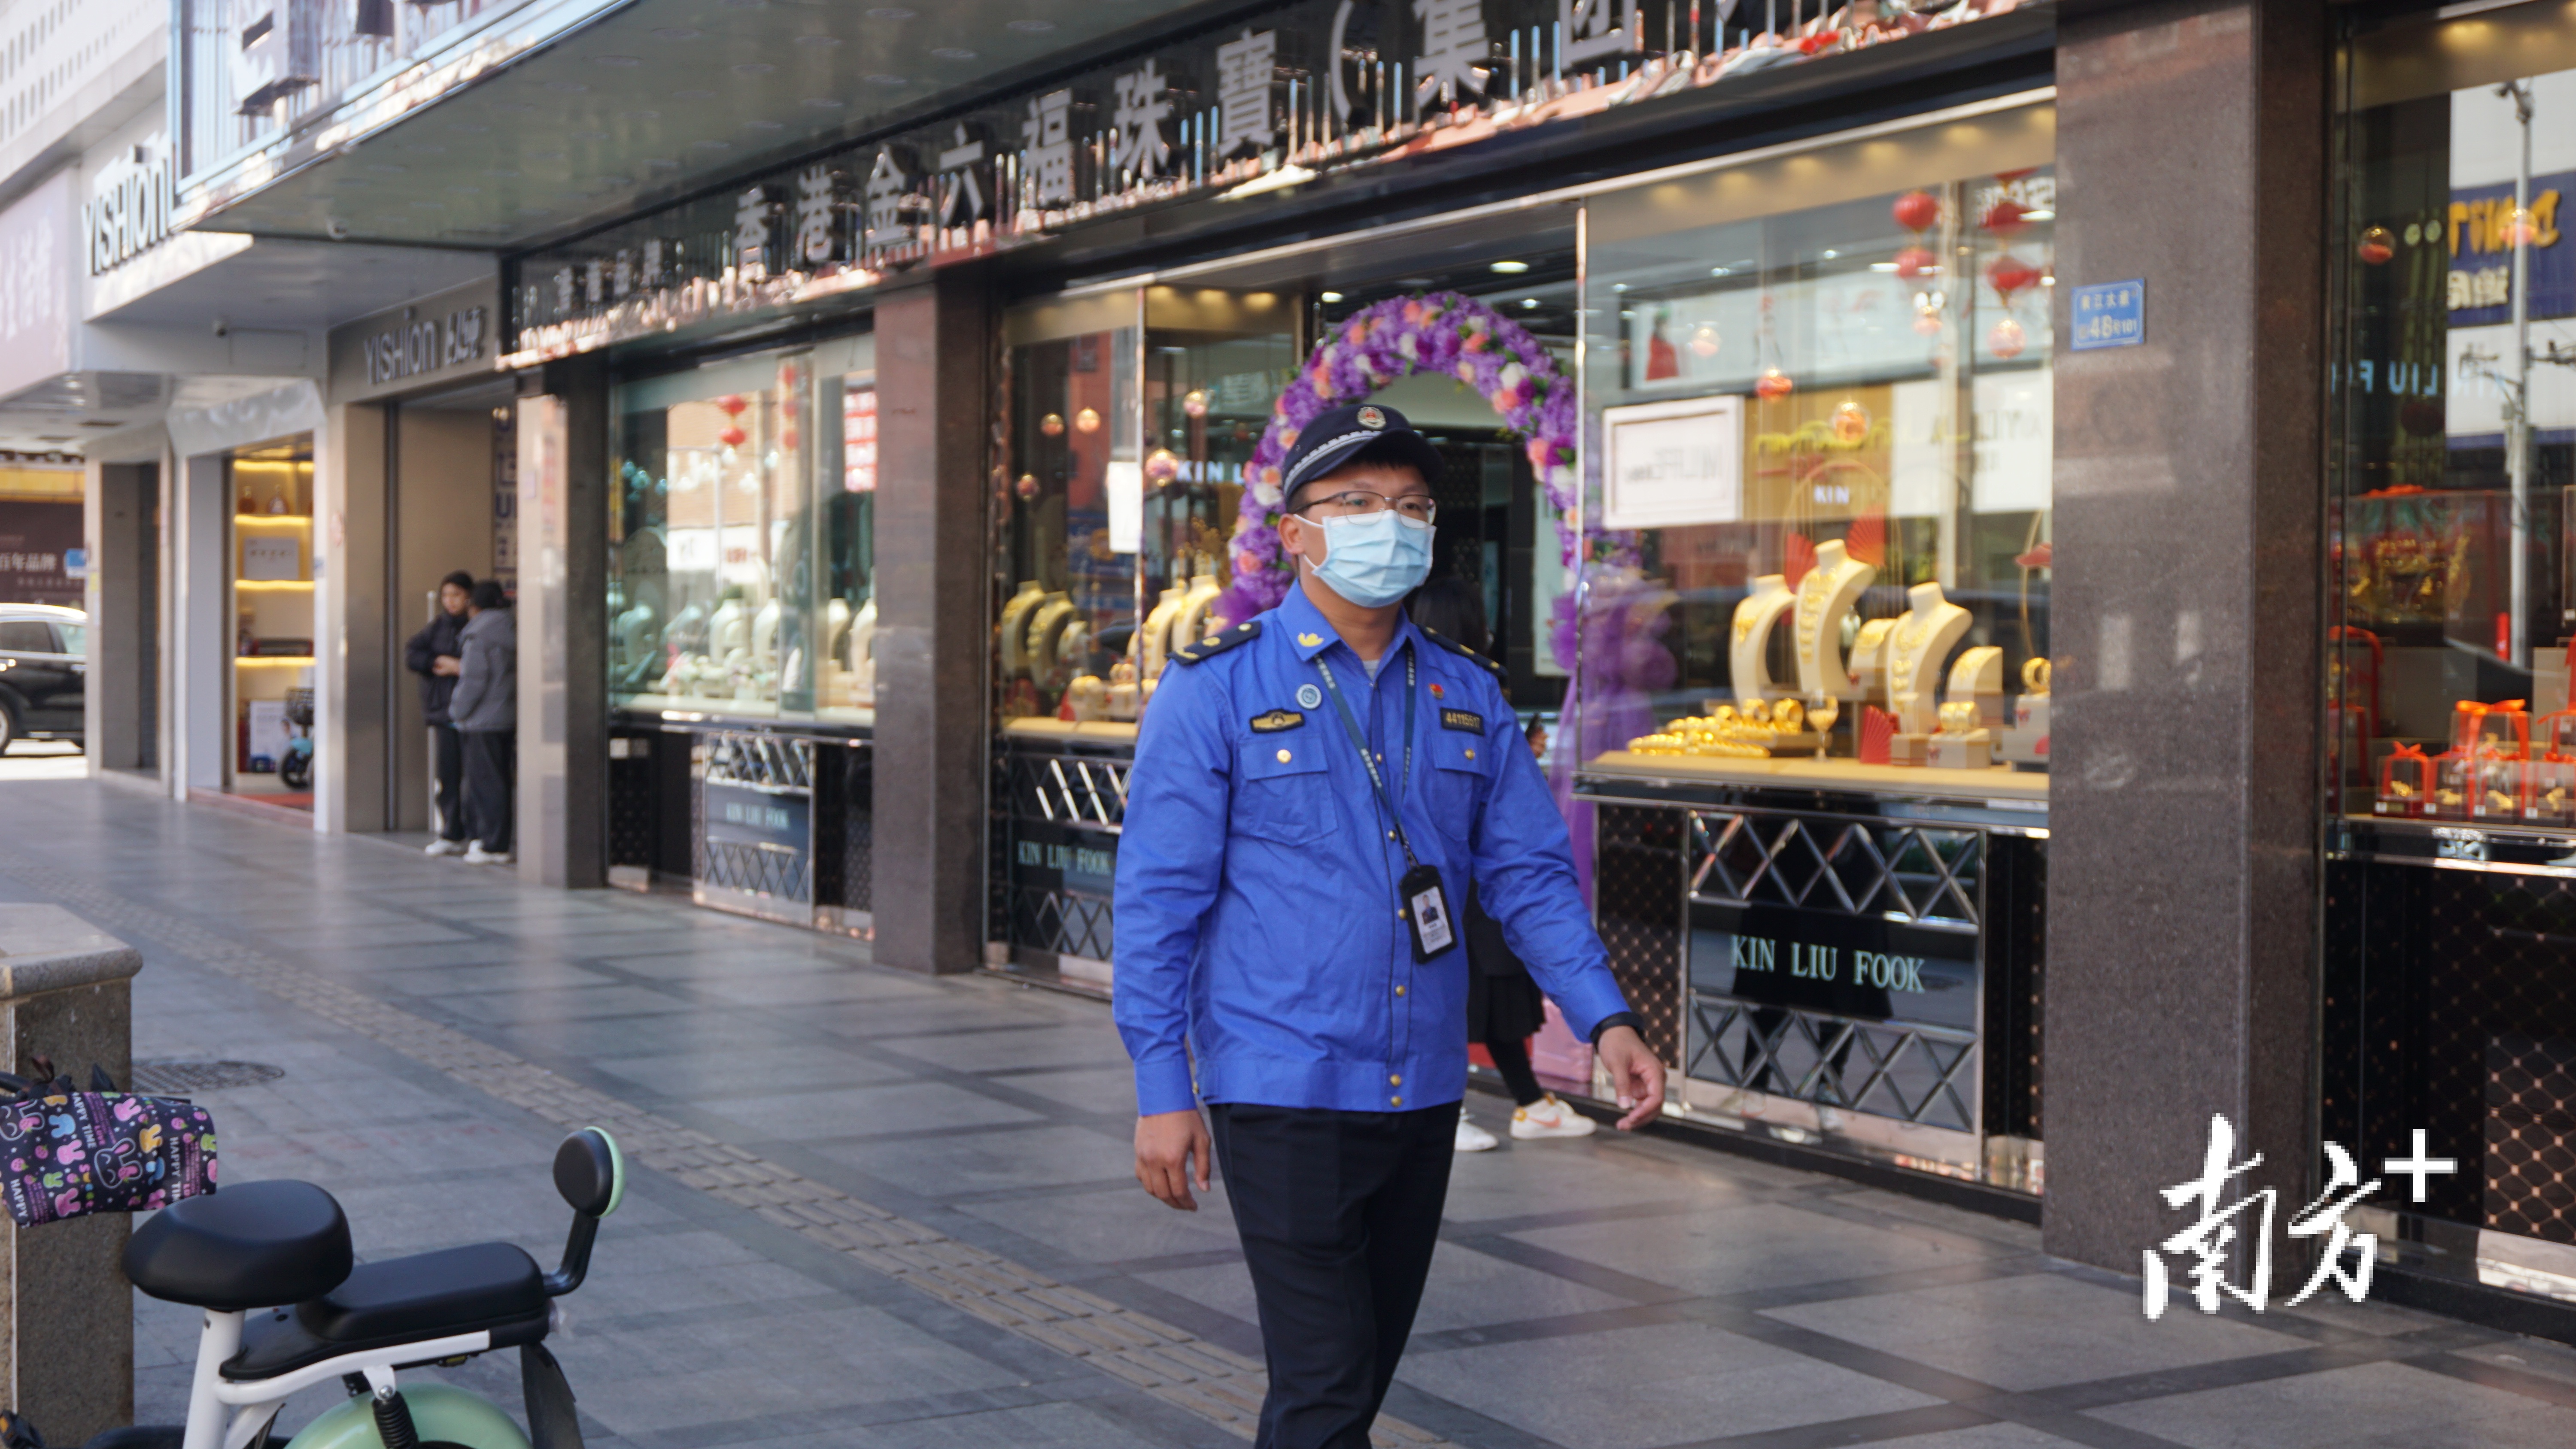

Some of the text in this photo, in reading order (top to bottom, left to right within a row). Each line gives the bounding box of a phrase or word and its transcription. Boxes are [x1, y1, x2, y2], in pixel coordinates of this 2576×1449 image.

[1814, 485, 1850, 504] KIN
[1729, 934, 1926, 994] KIN LIU FOOK
[82, 1123, 97, 1149] TIME
[170, 1137, 181, 1203] HAPPY TIM
[10, 1178, 28, 1218] HAPPY
